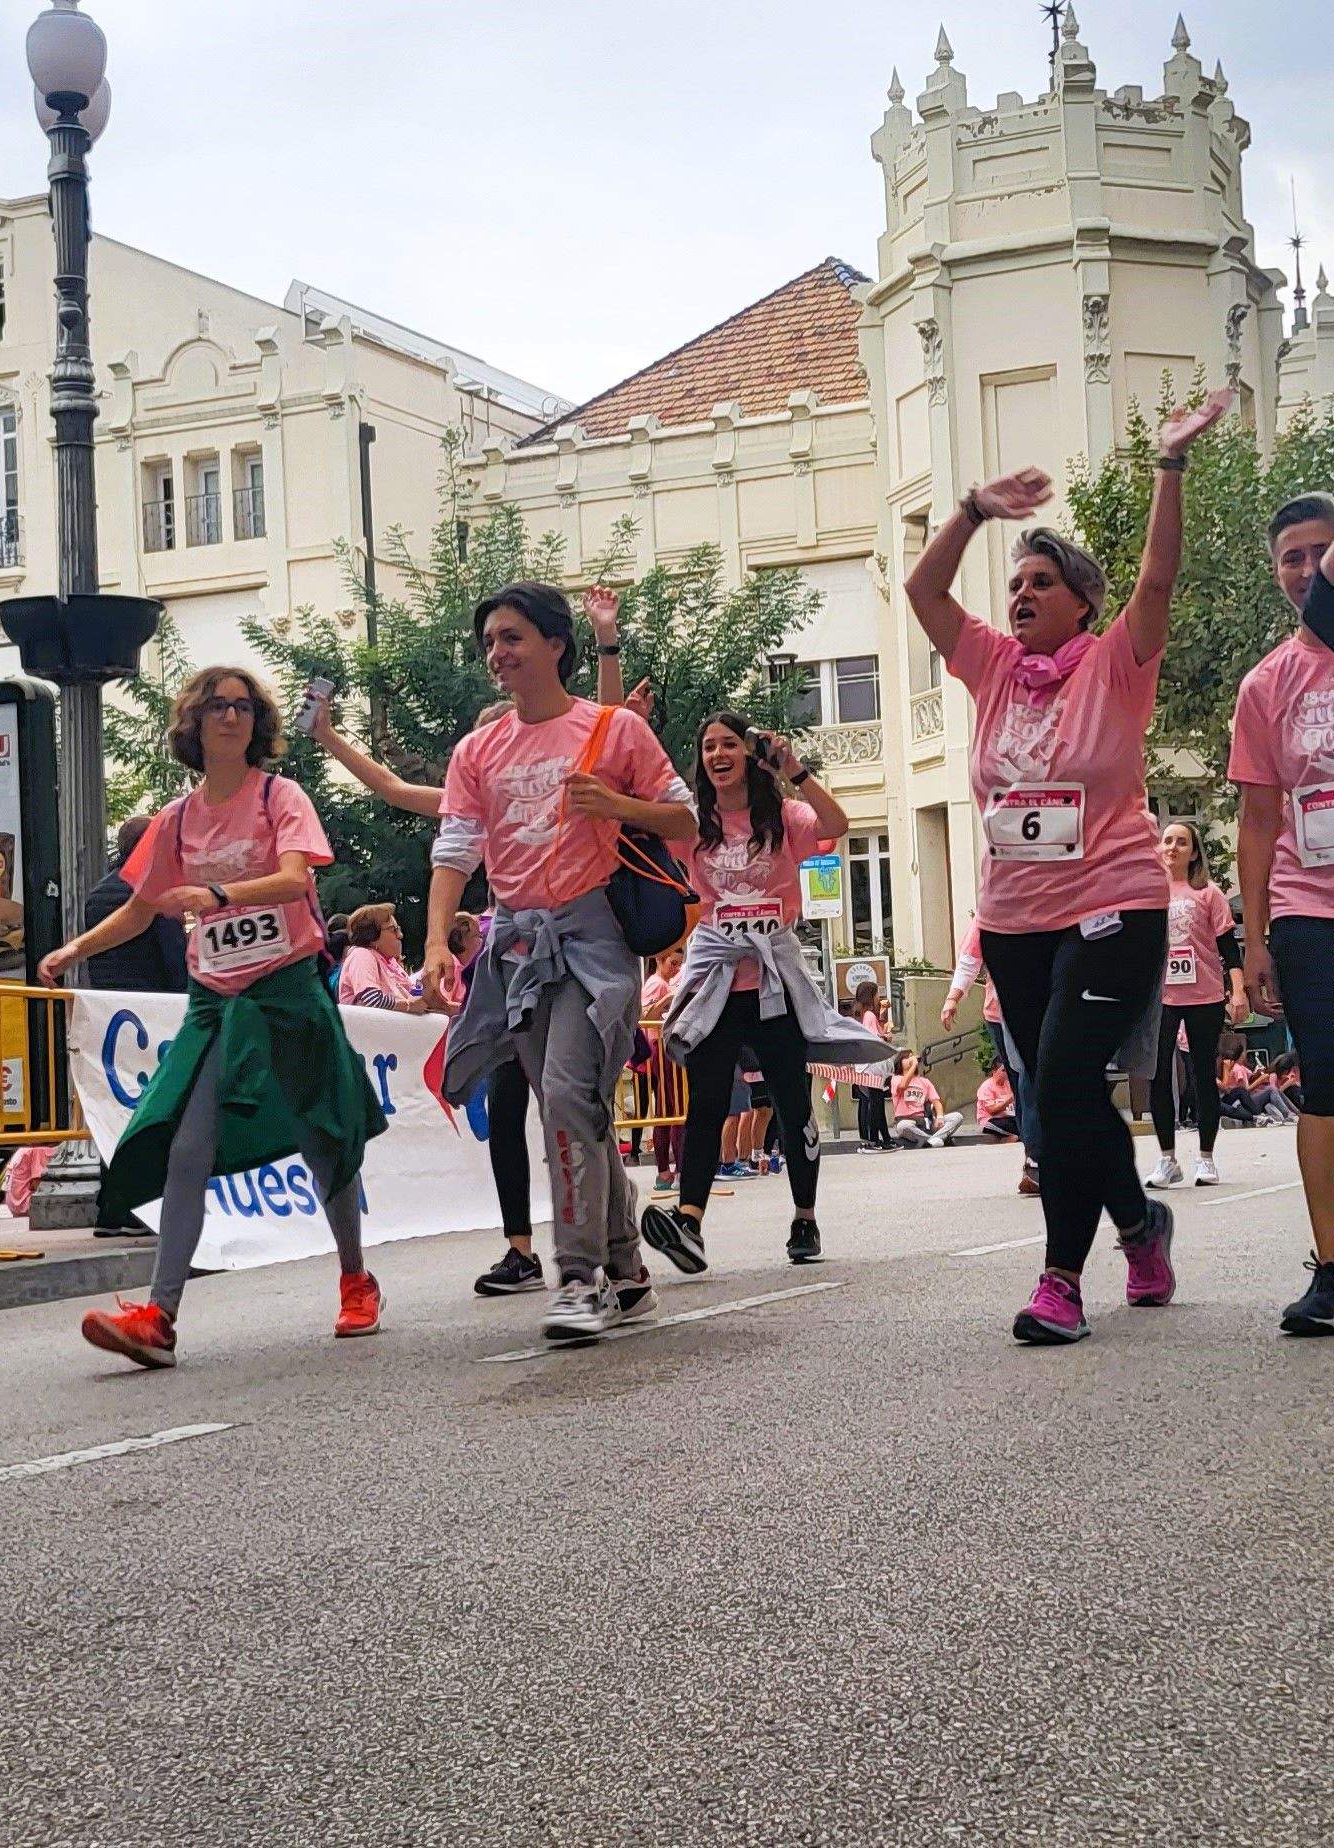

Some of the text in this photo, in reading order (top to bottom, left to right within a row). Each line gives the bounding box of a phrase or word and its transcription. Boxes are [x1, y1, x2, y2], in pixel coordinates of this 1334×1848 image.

[1021, 810, 1041, 841] 6
[205, 913, 279, 953] 1493
[1169, 959, 1192, 975] 90
